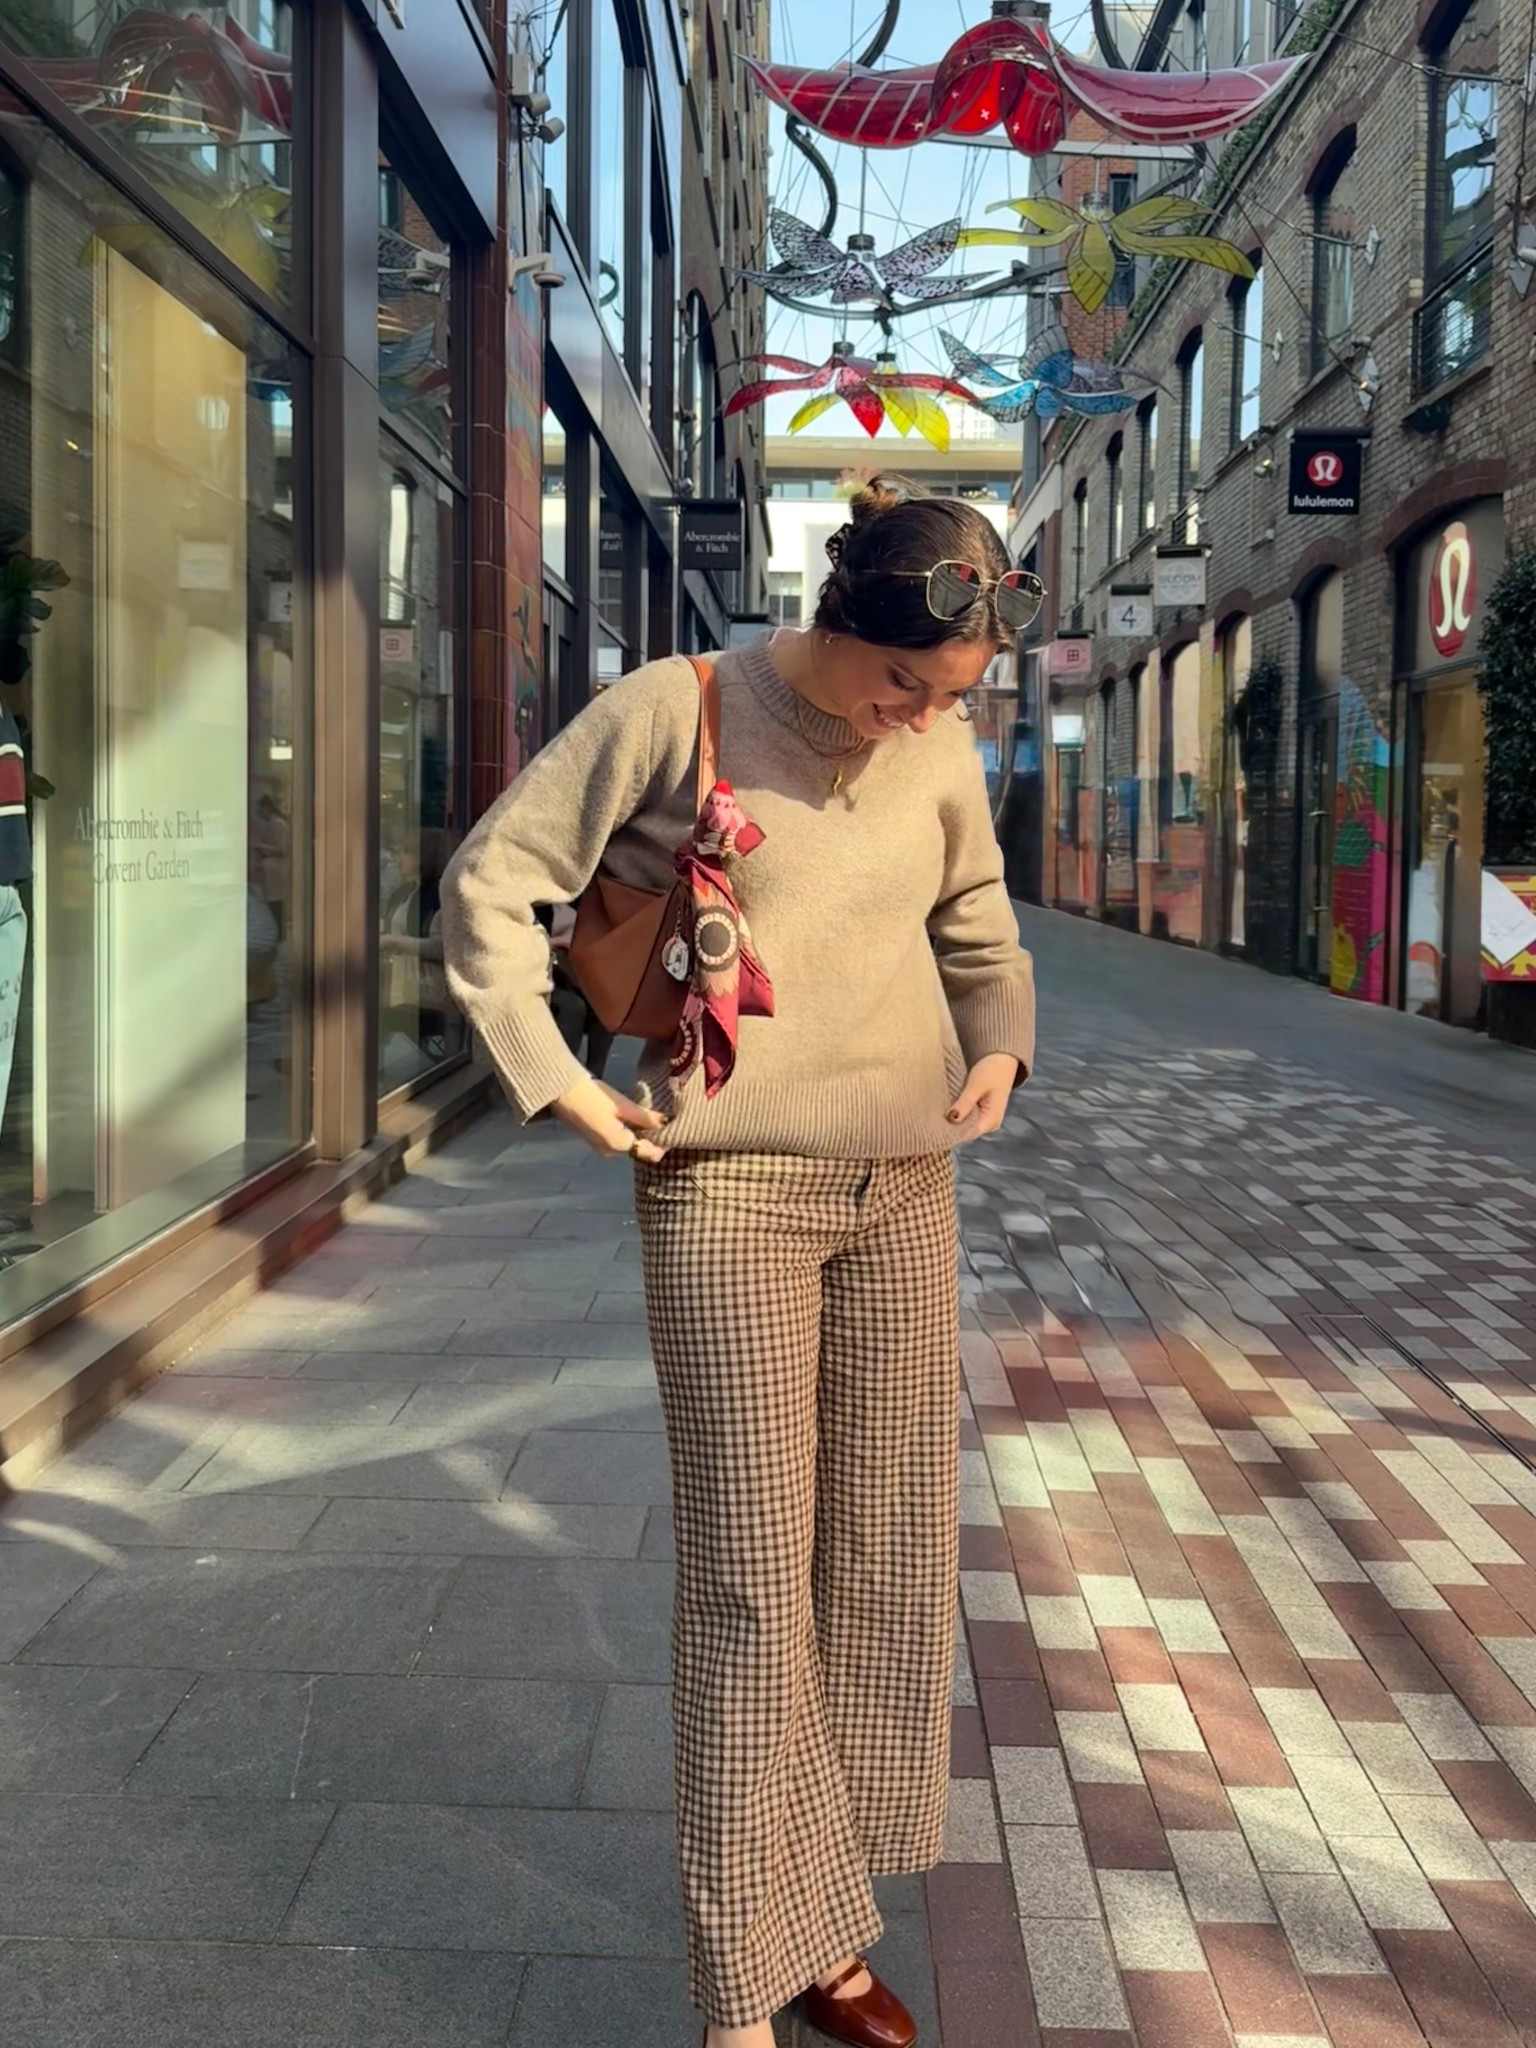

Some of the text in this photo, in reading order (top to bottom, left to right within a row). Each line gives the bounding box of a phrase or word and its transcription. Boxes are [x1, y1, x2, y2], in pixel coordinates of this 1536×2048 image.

[1293, 494, 1355, 508] lululemon
[684, 530, 741, 543] Abercrombie
[695, 541, 729, 553] & Fitch
[1121, 603, 1138, 629] 4
[74, 806, 204, 841] Abercrombie & Fitch
[93, 848, 190, 885] Covent Garden
